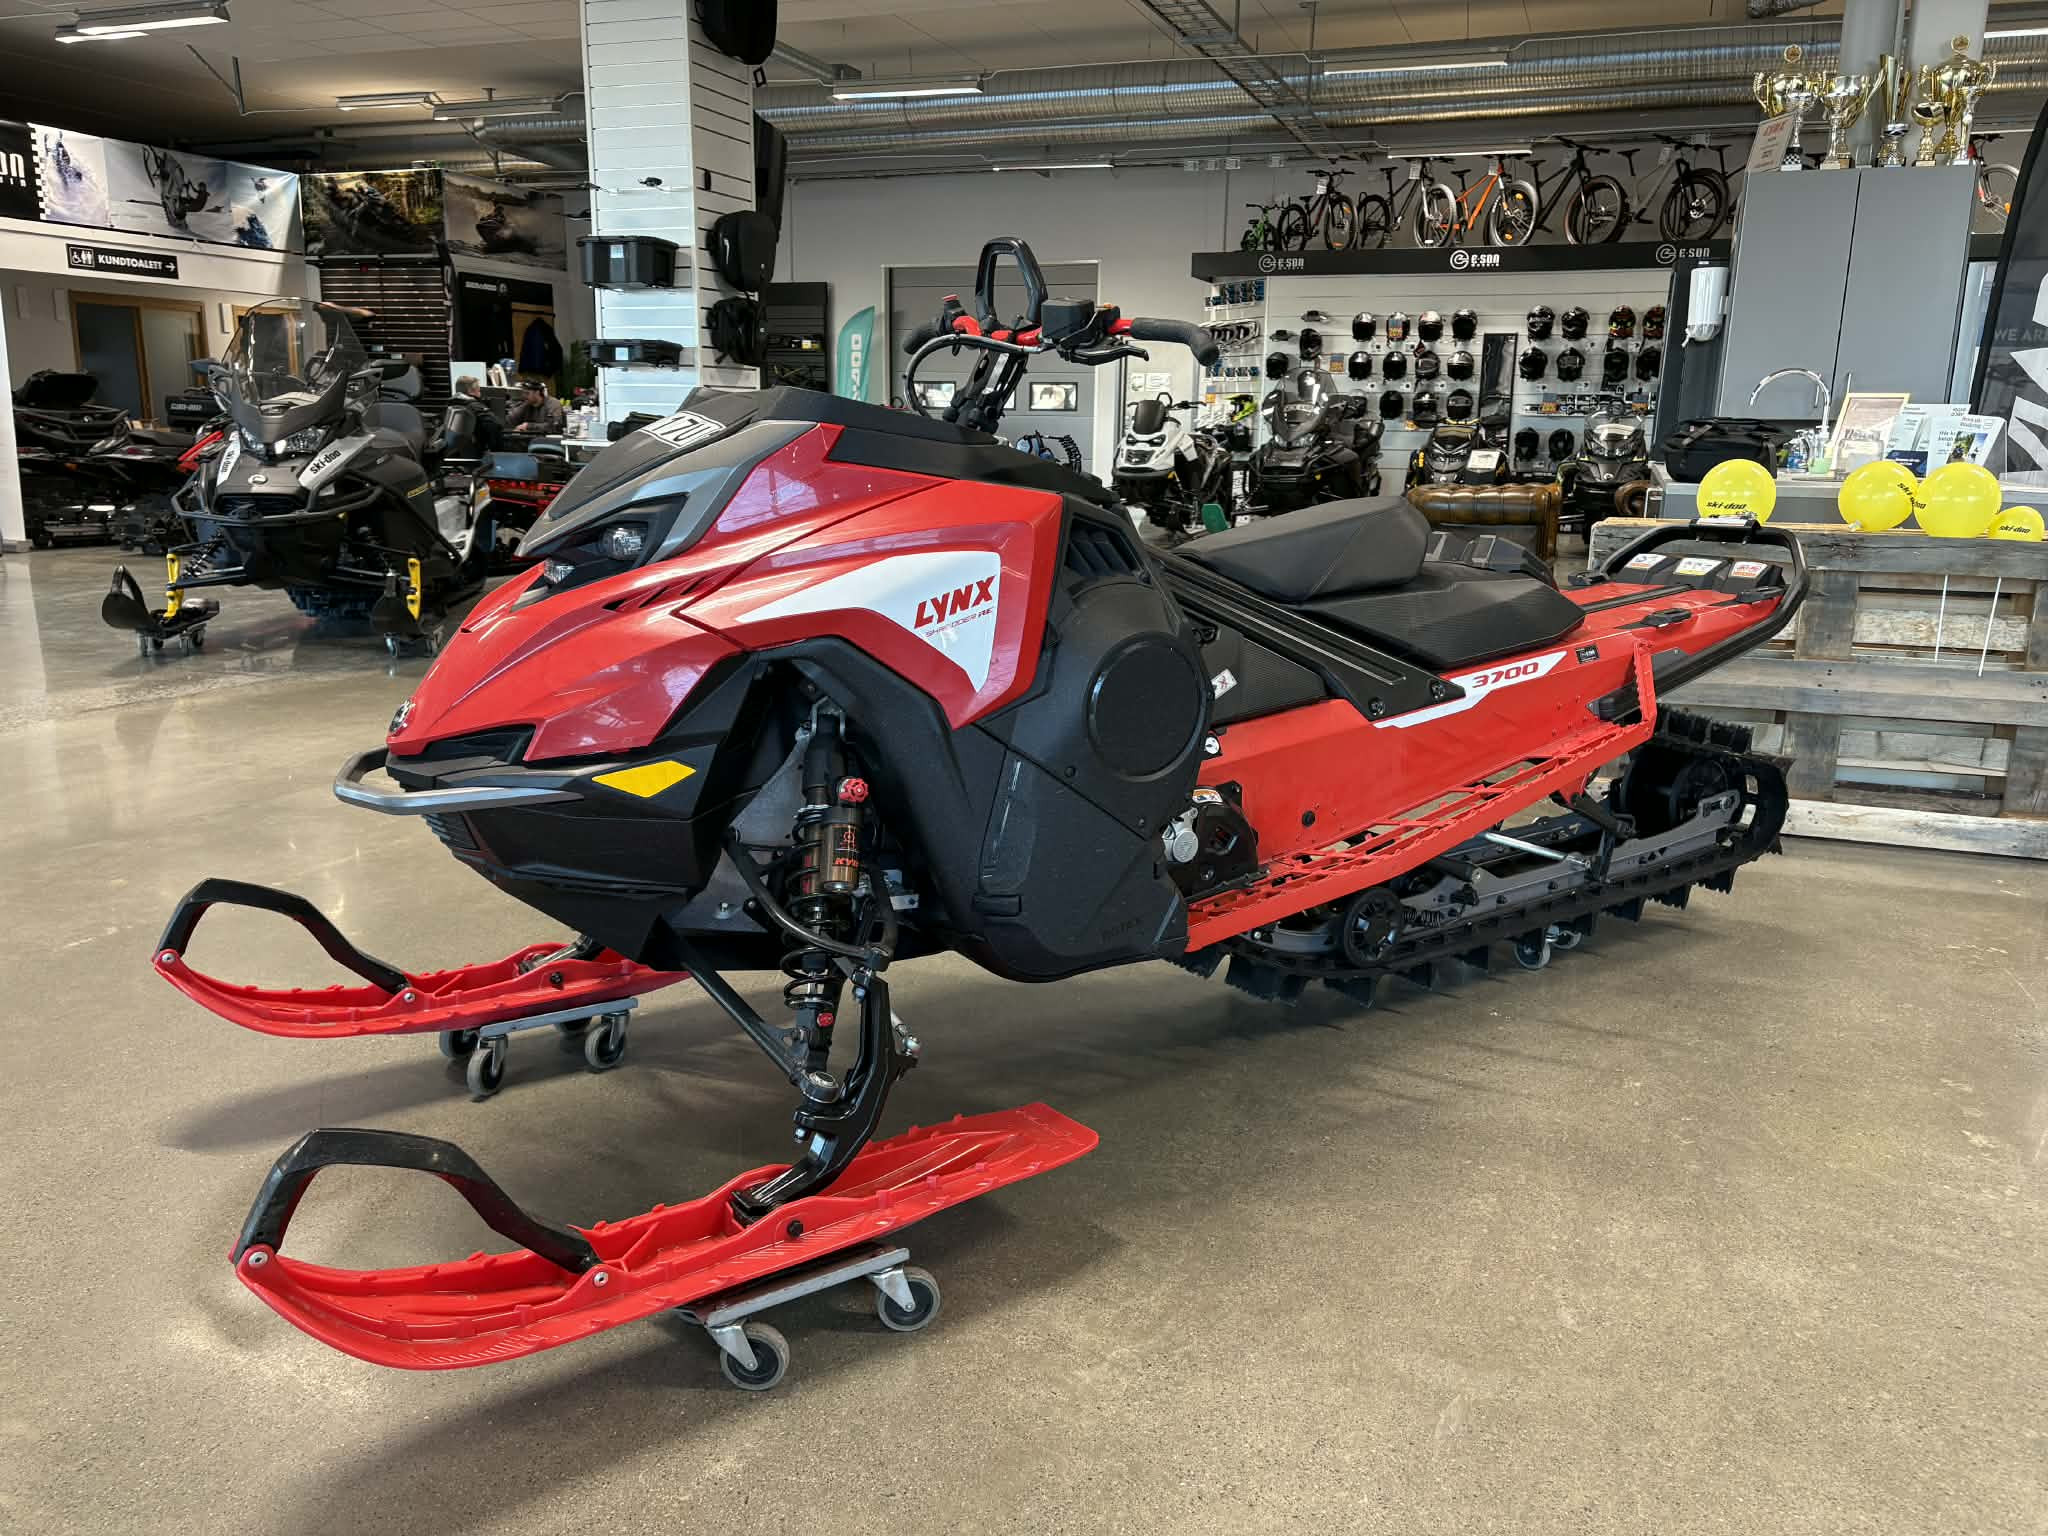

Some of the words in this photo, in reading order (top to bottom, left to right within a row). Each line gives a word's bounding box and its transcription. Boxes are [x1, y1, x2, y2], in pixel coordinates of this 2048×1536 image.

[98, 253, 163, 270] KUNDTOALETT
[1994, 328, 2017, 343] WE
[309, 449, 342, 475] ski-doo
[1706, 501, 1748, 511] ski-doo
[913, 574, 996, 630] LYNX
[1472, 661, 1539, 689] 3700
